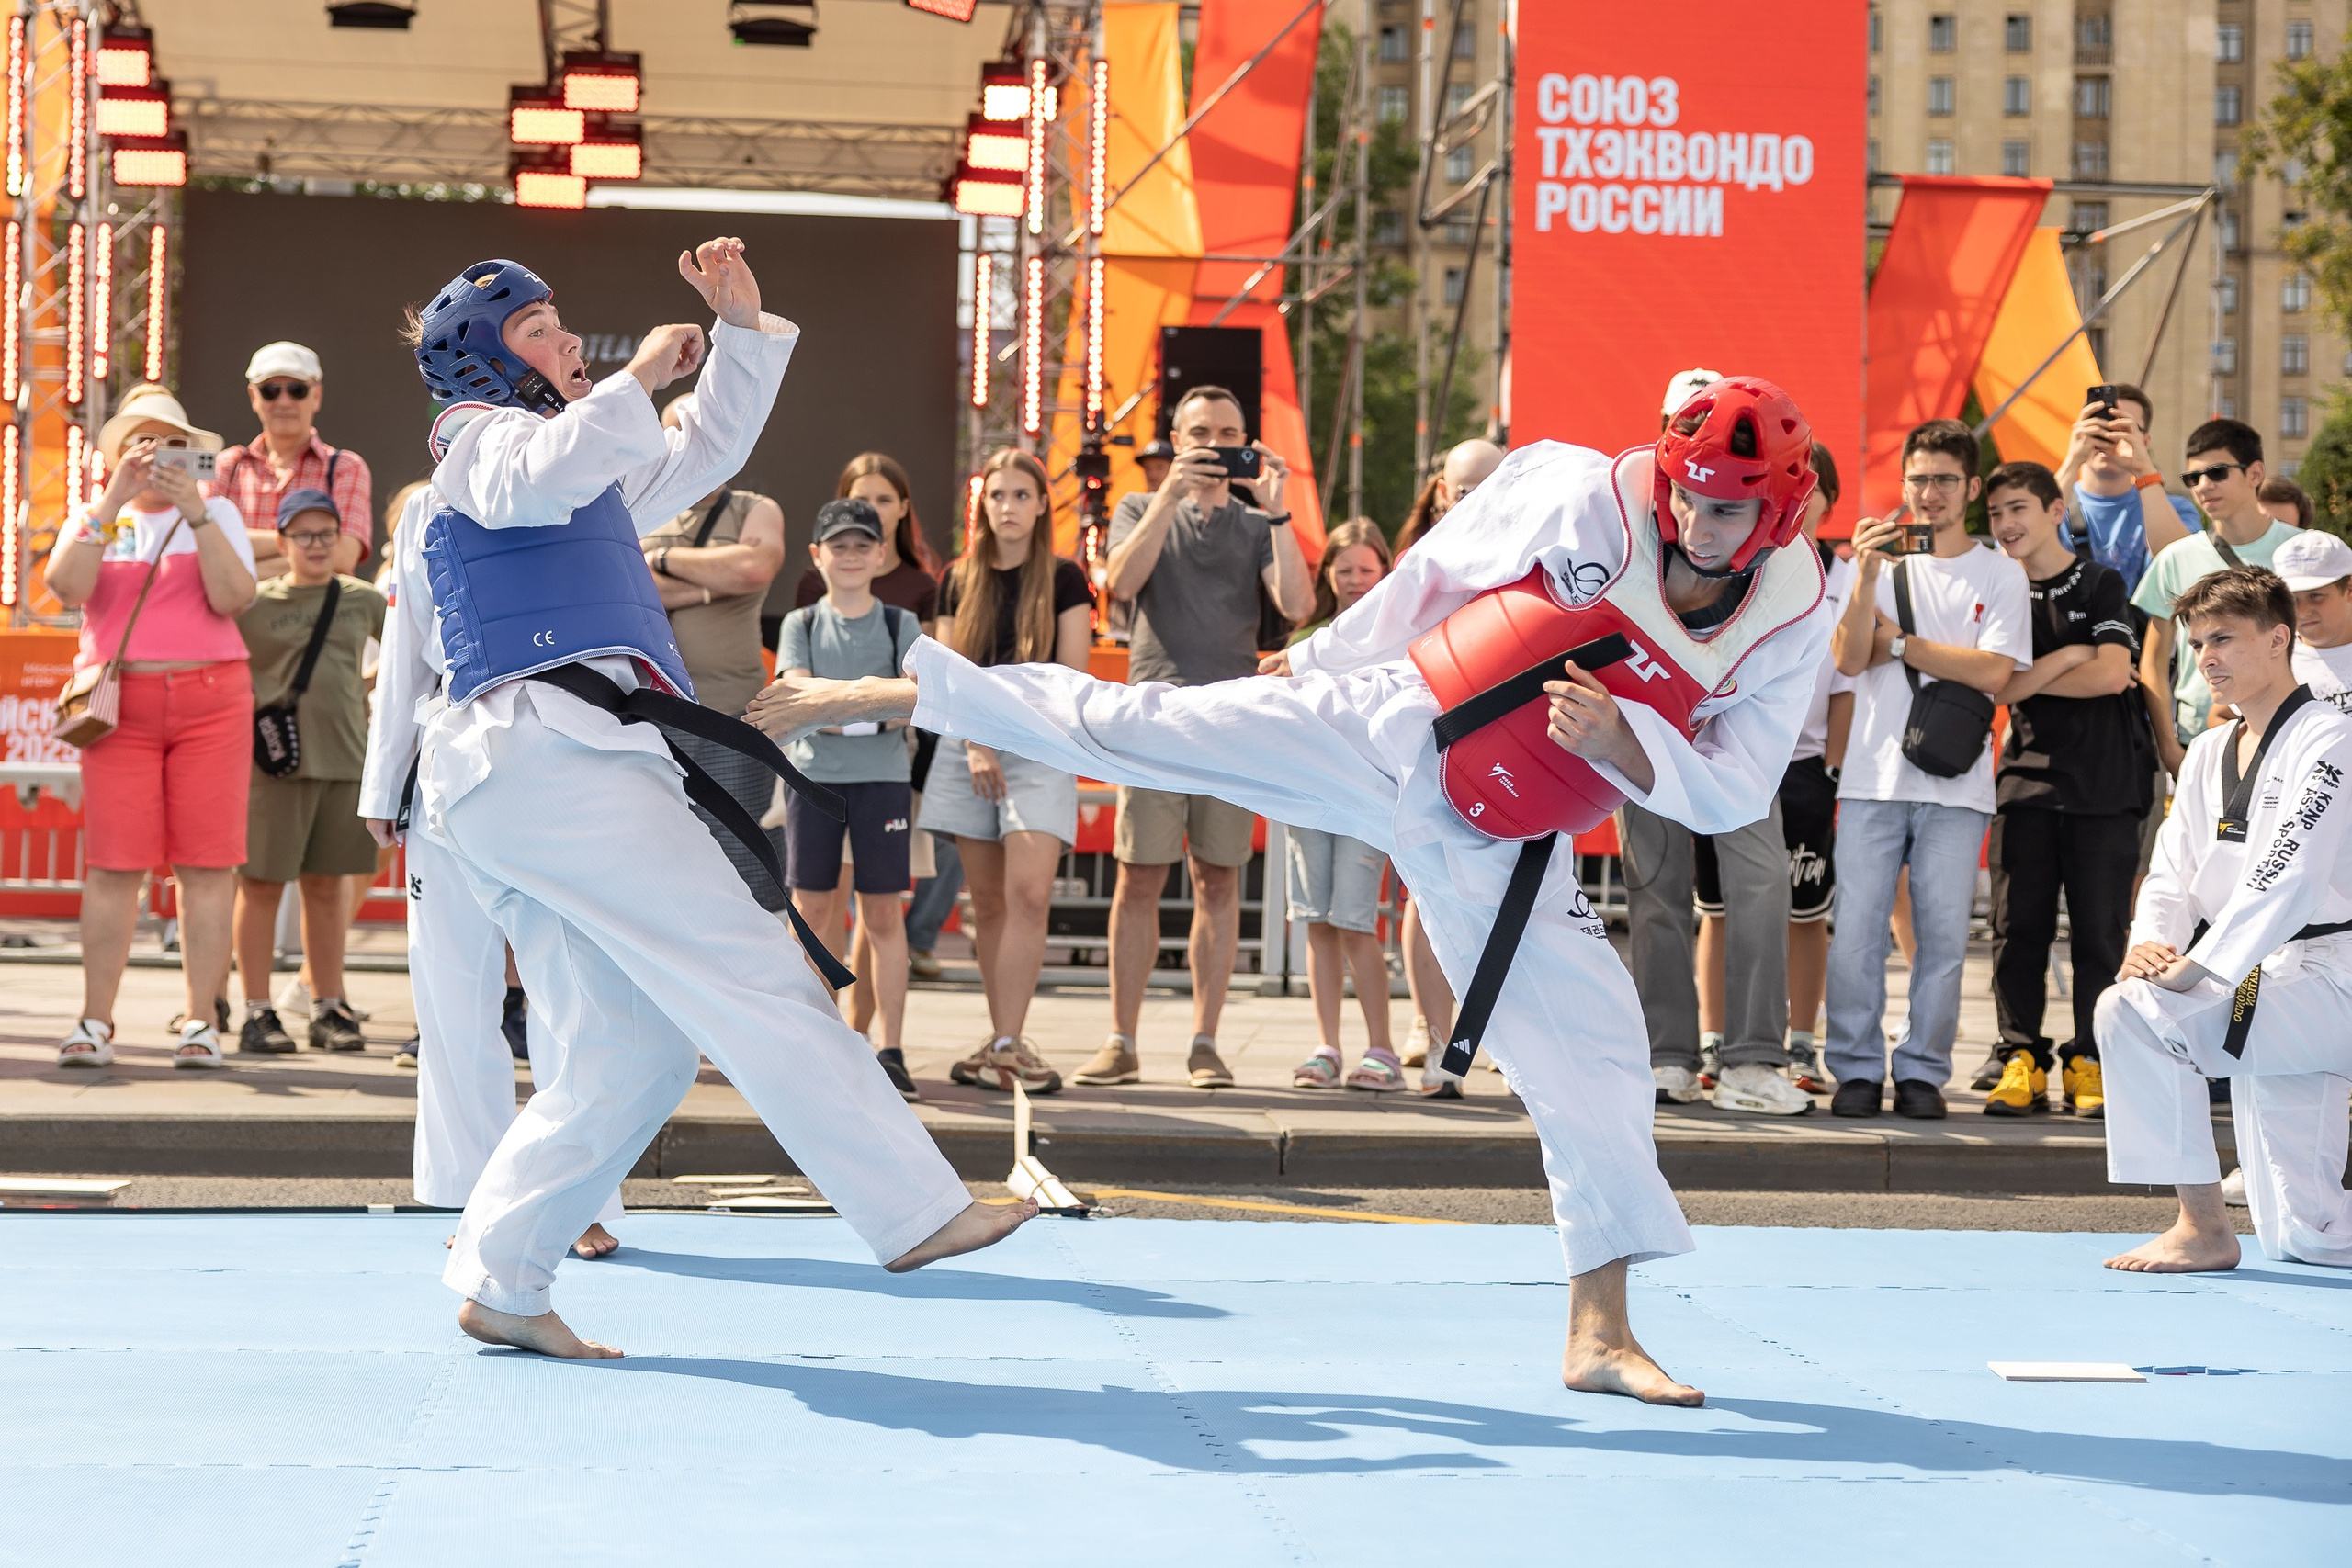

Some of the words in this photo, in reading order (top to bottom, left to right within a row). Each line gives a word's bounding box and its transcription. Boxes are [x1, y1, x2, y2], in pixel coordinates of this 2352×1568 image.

[1537, 73, 1679, 127] СОЮЗ
[1535, 127, 1815, 192] ТХЭКВОНДО
[1535, 181, 1724, 237] РОССИИ
[1469, 802, 1485, 818] 3
[2301, 791, 2333, 831] KPNP
[2254, 838, 2301, 892] RUSSIA
